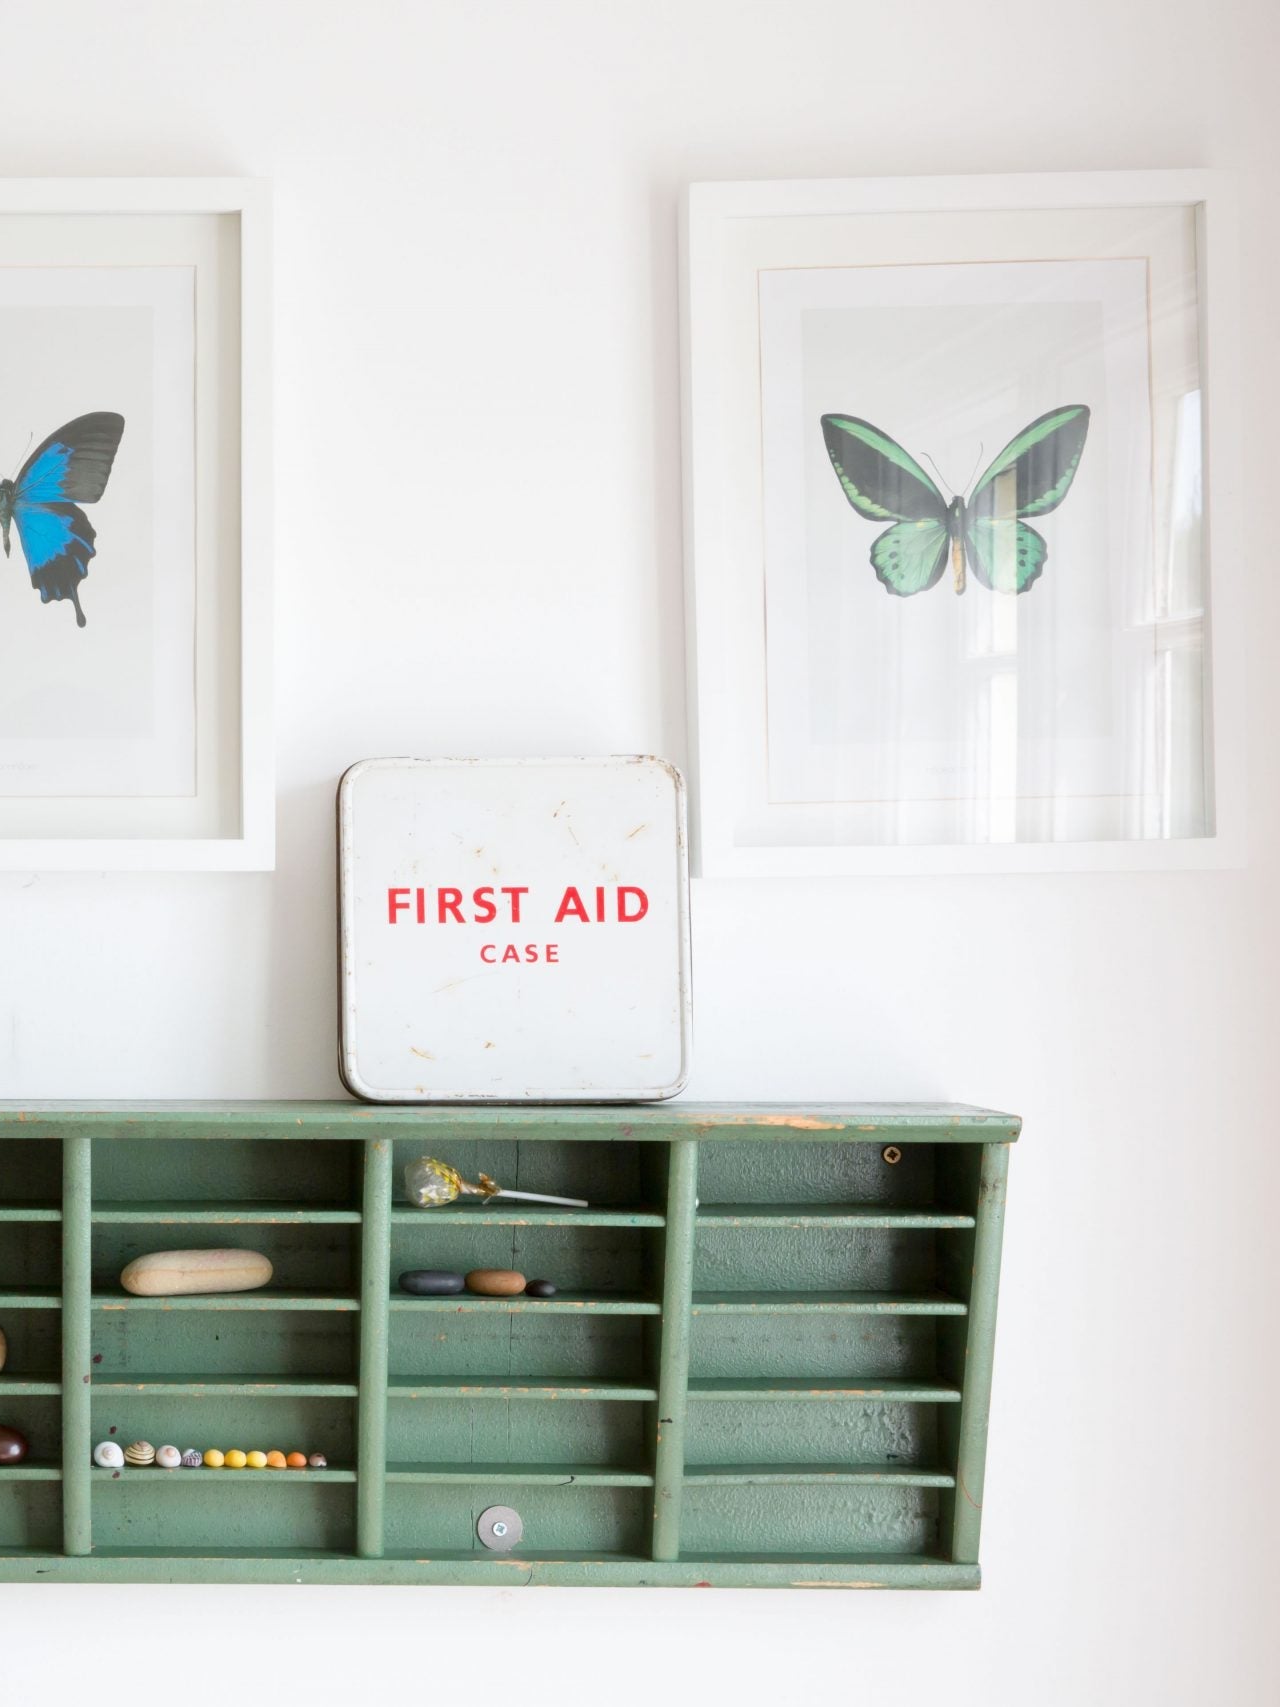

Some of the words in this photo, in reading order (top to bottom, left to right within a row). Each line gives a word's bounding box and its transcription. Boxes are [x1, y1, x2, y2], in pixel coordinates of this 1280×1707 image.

[387, 886, 529, 925] FIRST
[554, 885, 650, 923] AID
[479, 943, 560, 964] CASE
